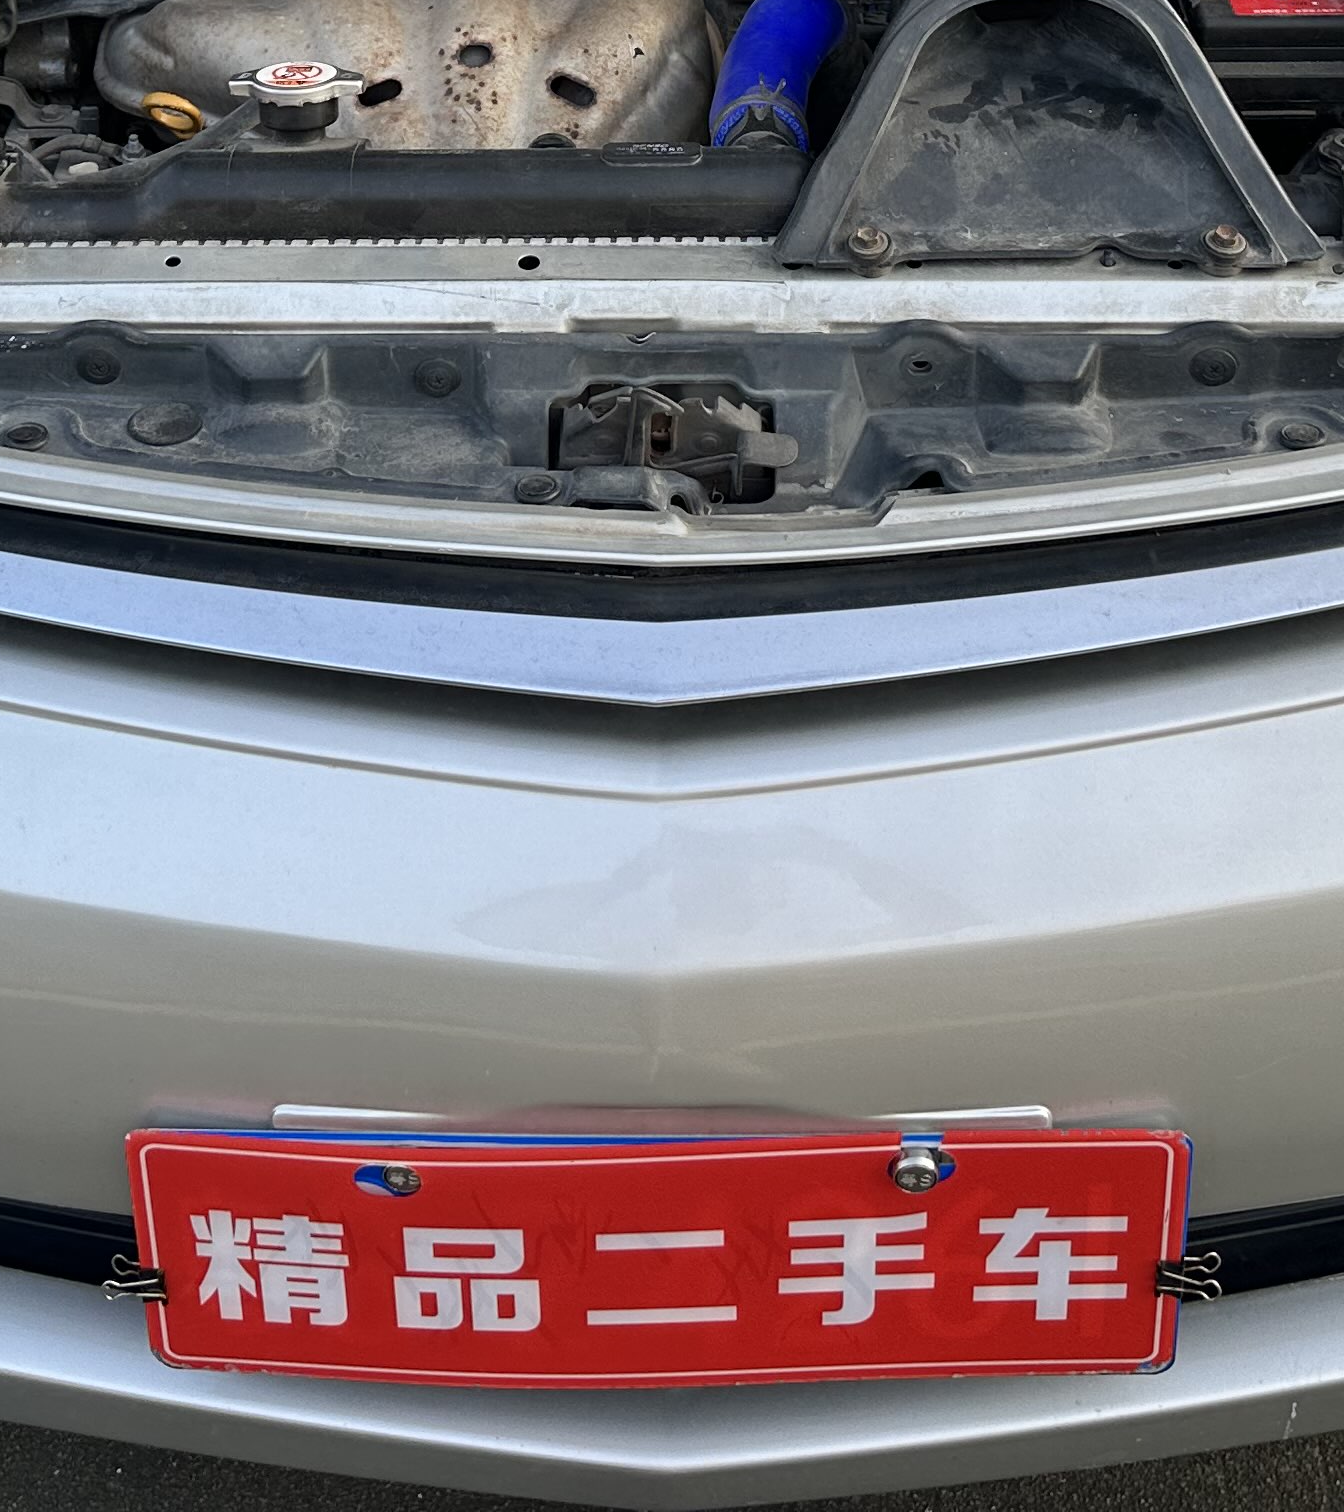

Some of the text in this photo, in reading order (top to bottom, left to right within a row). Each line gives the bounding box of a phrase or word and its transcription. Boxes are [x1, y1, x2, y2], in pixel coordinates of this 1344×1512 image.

[189, 1206, 1129, 1333] 精品二手车
